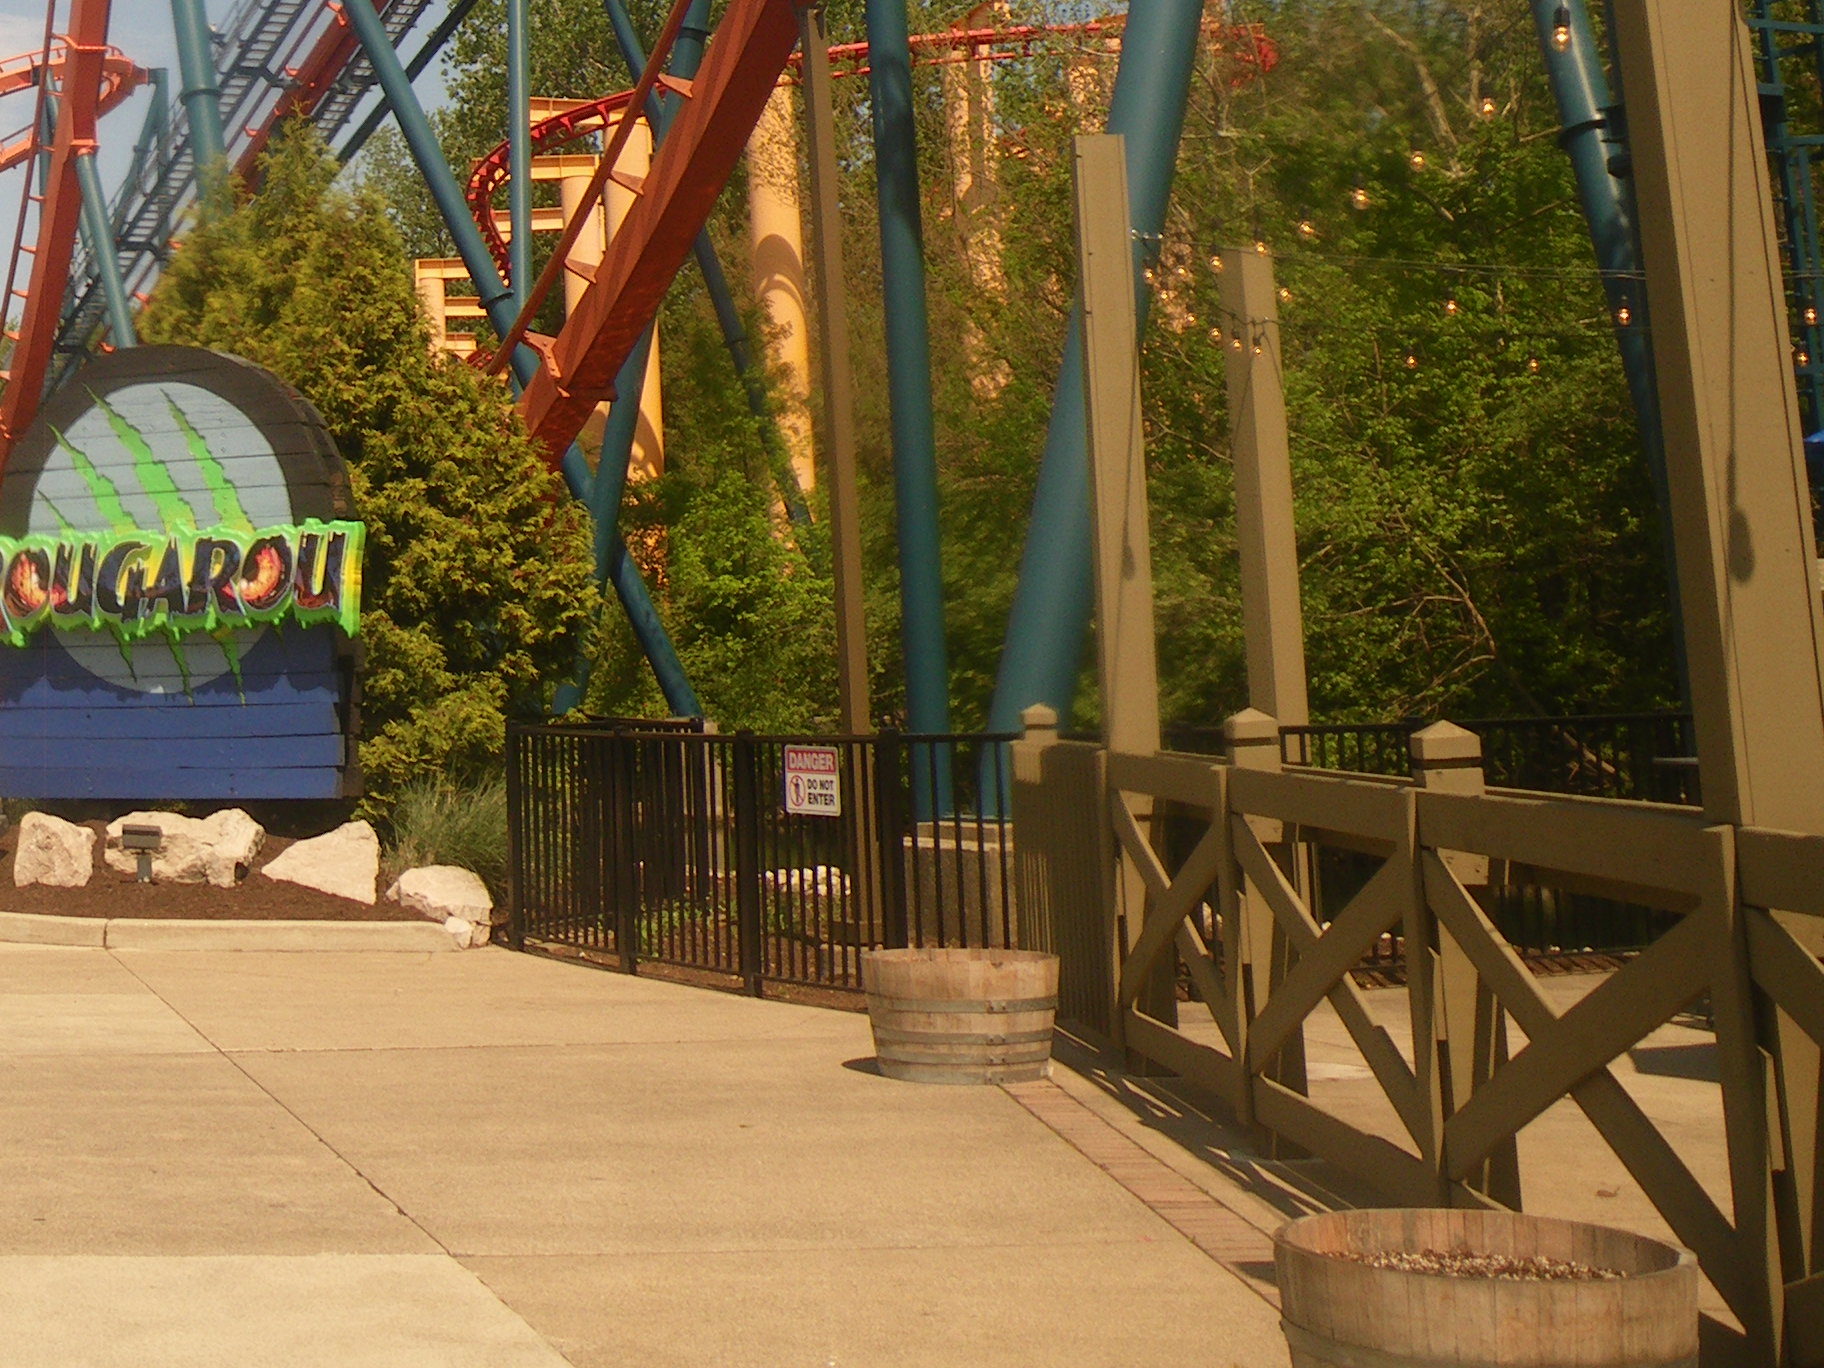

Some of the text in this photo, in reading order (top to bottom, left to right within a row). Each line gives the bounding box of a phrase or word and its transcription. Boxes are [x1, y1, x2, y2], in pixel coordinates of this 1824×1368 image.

[789, 751, 834, 770] DANGER
[807, 778, 834, 791] DO NOT
[807, 792, 836, 806] ENTER
